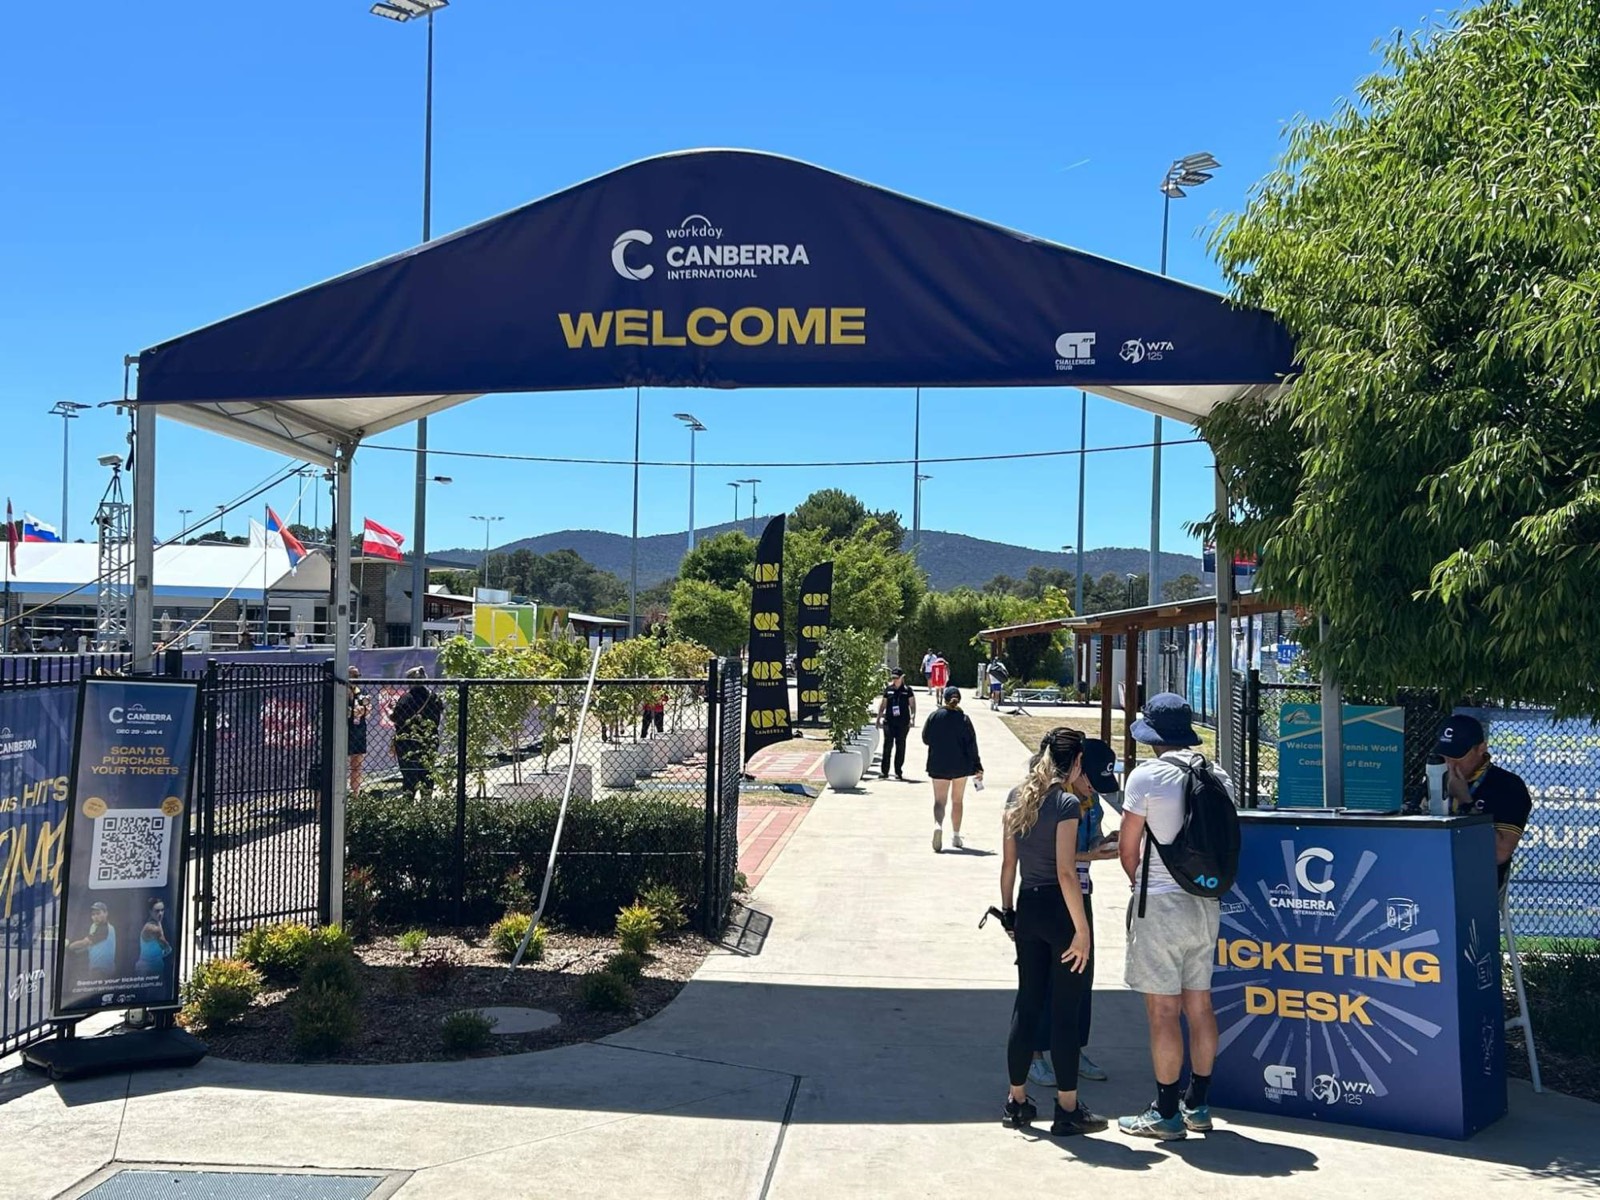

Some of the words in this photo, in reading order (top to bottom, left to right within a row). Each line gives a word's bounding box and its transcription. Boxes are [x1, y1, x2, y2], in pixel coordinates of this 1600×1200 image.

[666, 226, 723, 239] workday
[666, 244, 810, 267] CANBERRA
[667, 268, 757, 281] INTERNATIONAL
[558, 307, 866, 348] WELCOME
[1147, 341, 1174, 351] WTA
[1147, 351, 1163, 361] 125
[127, 713, 172, 721] CANBERRA
[751, 708, 789, 728] CBR
[111, 746, 146, 755] SCAN
[148, 746, 165, 755] TO
[1370, 744, 1398, 752] World
[102, 756, 171, 765] PURCHASE
[1358, 761, 1381, 769] Entry
[91, 766, 127, 775] YOUR
[129, 766, 179, 775] TICKETS
[22, 776, 69, 808] HITS
[1269, 897, 1336, 911] CANBERRA
[1293, 909, 1337, 917] INTERNATIONAL
[1217, 938, 1441, 983] ICKETING
[1245, 986, 1373, 1026] DESK
[1342, 1080, 1376, 1095] WTA
[1343, 1093, 1363, 1105] 125
